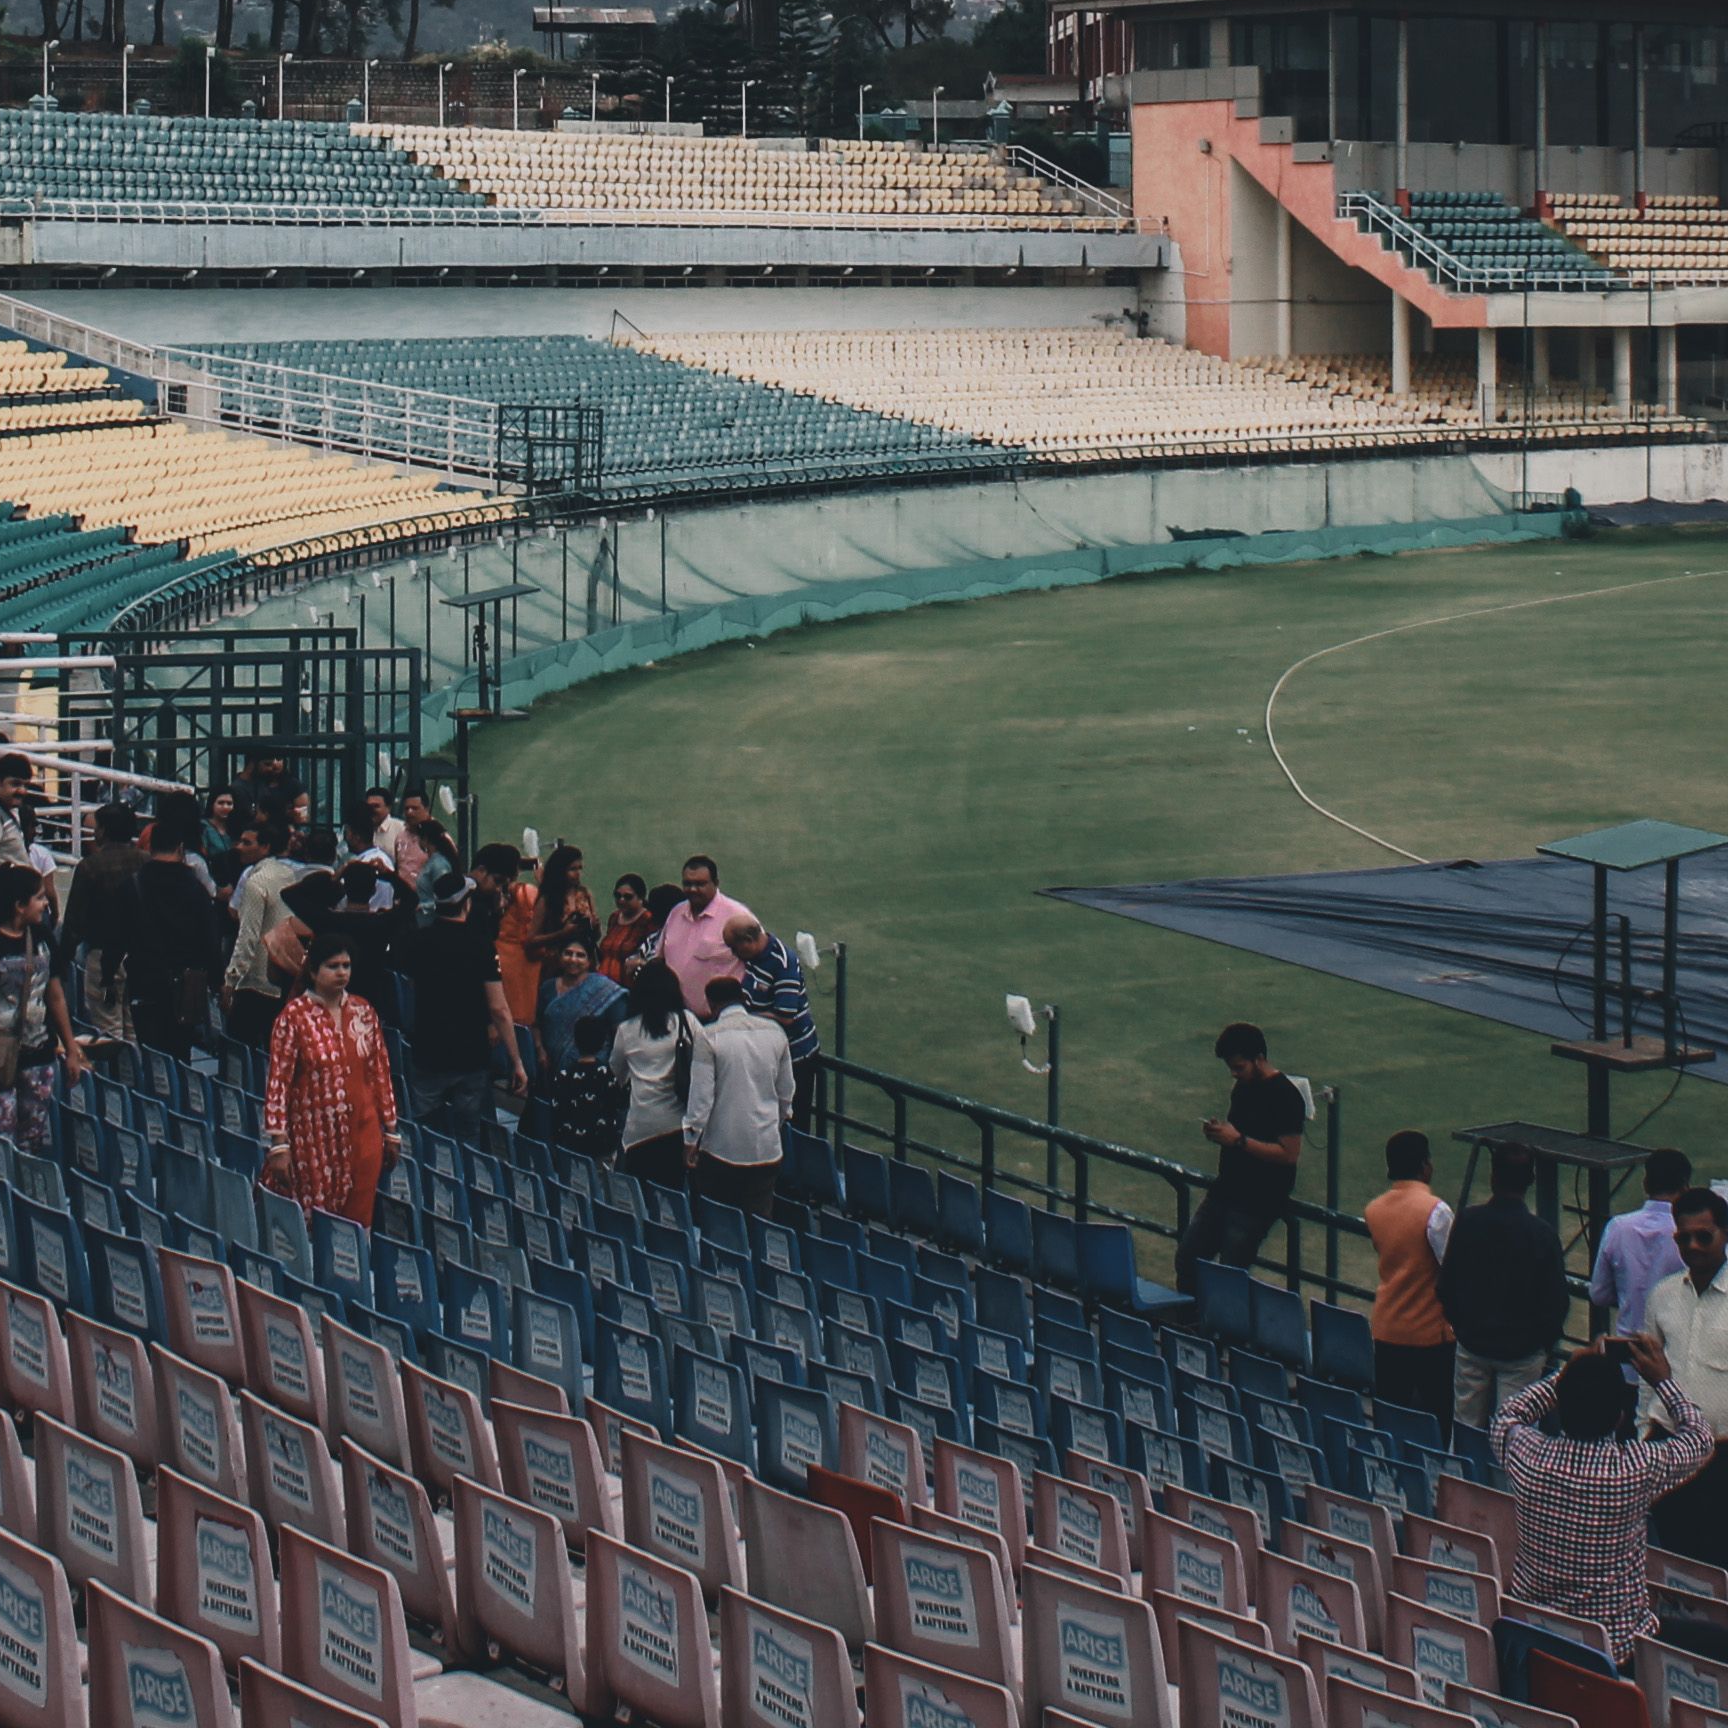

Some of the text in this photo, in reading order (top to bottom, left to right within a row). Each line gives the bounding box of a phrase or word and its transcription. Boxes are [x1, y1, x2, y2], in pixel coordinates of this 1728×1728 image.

[528, 1442, 569, 1480] ARISE
[69, 1470, 111, 1512] ARISE
[534, 1477, 570, 1497] INVERTERS
[538, 1490, 574, 1512] BATTERIES
[655, 1482, 696, 1520] ARISE
[74, 1505, 109, 1534] INVERTERS
[657, 1516, 695, 1539] INVERTERS
[77, 1524, 112, 1552] BATTERIES
[487, 1517, 530, 1563] ARISE
[661, 1530, 698, 1555] BATTERIES
[202, 1537, 250, 1574] ARISE
[490, 1552, 527, 1585] INVERTERS
[206, 1580, 247, 1602] INVERTERS
[493, 1568, 530, 1602] BATTERIES
[910, 1562, 960, 1595] ARISE
[1429, 1582, 1471, 1606] ARISE
[210, 1598, 252, 1621] BATTERIES
[324, 1585, 371, 1635] ARISE
[626, 1583, 671, 1624] ARISE
[915, 1601, 961, 1617] INVERTERS
[627, 1622, 669, 1652] INVERTERS
[923, 1617, 967, 1634] BATTERIES
[328, 1629, 372, 1663] INVERTERS
[630, 1640, 673, 1670] BATTERIES
[1064, 1626, 1120, 1664] ARISE
[1422, 1642, 1461, 1671] ARISE
[332, 1649, 376, 1684] BATTERIES
[757, 1635, 805, 1688] ARISE
[1070, 1665, 1119, 1688] INVERTERS
[136, 1670, 186, 1712] ARISE
[759, 1677, 803, 1711] INVERTERS
[1075, 1681, 1124, 1704] BATTERIES
[1222, 1667, 1276, 1710] ARISE
[762, 1696, 806, 1728] BATTERIES
[1225, 1707, 1276, 1728] INVERTERS
